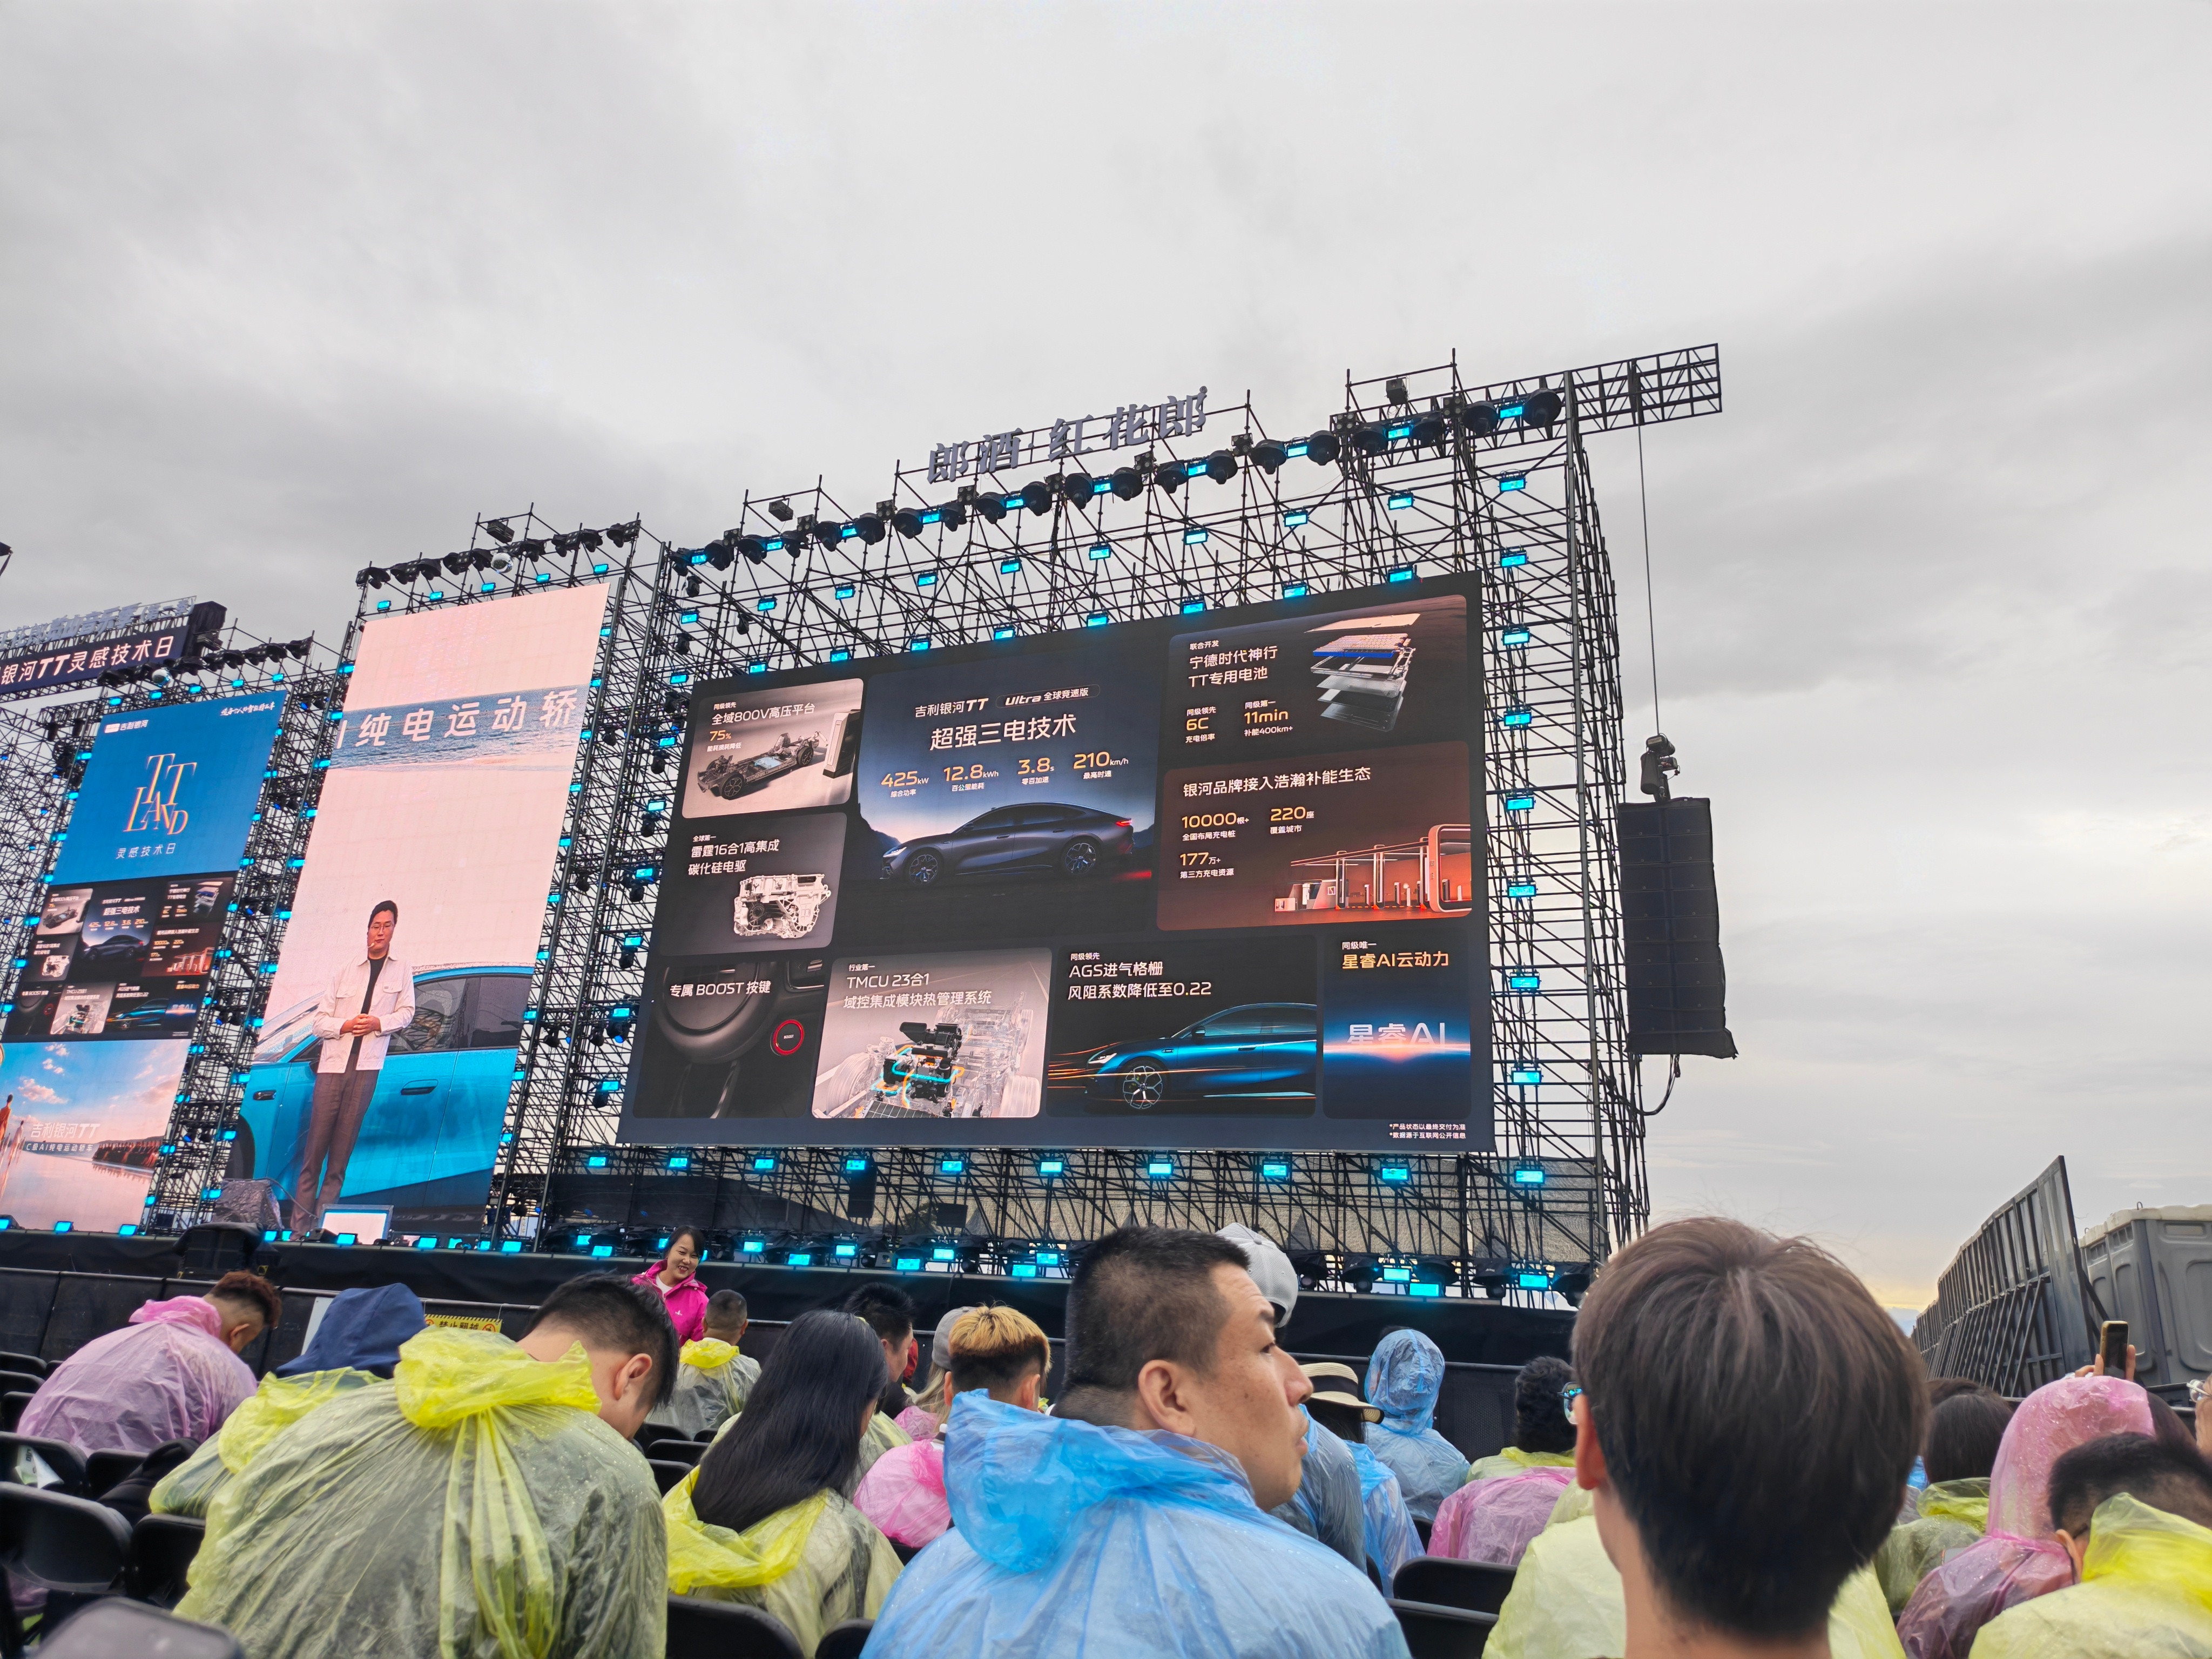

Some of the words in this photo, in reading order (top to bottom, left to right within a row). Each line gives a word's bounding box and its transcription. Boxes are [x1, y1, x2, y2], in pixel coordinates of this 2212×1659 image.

[1189, 639, 1219, 650] 联合开发
[0, 636, 174, 684] 银河TT灵感技术日
[1189, 645, 1278, 670] 宁德时代神行
[1188, 666, 1268, 687] TT专用电池
[914, 697, 989, 718] 吉利银河TT
[1004, 696, 1042, 706] Ultra
[1043, 687, 1089, 702] 全球竞速版
[1245, 700, 1276, 710] 同级第一
[711, 703, 815, 725] 全域800V高压平台
[1186, 706, 1216, 717] 同级领先
[1244, 709, 1289, 724] 11min
[929, 713, 1076, 751] 超强三电技术
[1186, 717, 1209, 731] 6C
[1244, 726, 1293, 737] 补能400km+
[710, 730, 731, 741] 75%
[1185, 733, 1215, 744] 充电倍率
[1017, 758, 1054, 775] 3.8s
[1073, 751, 1129, 770] 210km/h
[141, 753, 197, 806] TT
[881, 770, 929, 787] 425kW
[943, 764, 999, 781] 12.8kWh
[1021, 775, 1049, 785] 零百加速
[1083, 770, 1111, 779] 最高时速
[952, 782, 984, 792] 百公里能耗
[1183, 766, 1371, 797] 银河品牌接入浩瀚补能生态
[891, 788, 916, 798] 综合功率
[1270, 806, 1314, 821] 220座
[1182, 830, 1236, 841] 全国布局充电桩
[1270, 824, 1303, 834] 覆盖城市
[116, 843, 176, 859] 灵感技术日
[691, 839, 780, 858] 雷霆16合1高集成
[1179, 852, 1221, 866] 177万+
[687, 859, 747, 876] 碳化硅电驱
[1179, 868, 1234, 879] 第三方充电资源
[1341, 941, 1377, 950] 同级唯一
[1070, 952, 1100, 961] 同级领先
[1342, 950, 1449, 969] 星睿AI云动力
[848, 963, 875, 972] 行业第一
[1069, 961, 1163, 978] AGS进气格栅
[670, 984, 694, 997] 专属
[696, 982, 745, 996] BOOST
[746, 980, 771, 994] 按键
[846, 975, 889, 988] TMCU
[892, 973, 929, 987] 23合1
[1068, 982, 1211, 1000] 风阻系数降低至0.22
[843, 990, 992, 1009] 域控集成模块热管理系统
[1347, 1022, 1445, 1048] 星睿AI
[31, 1122, 100, 1138] 吉利银河TT
